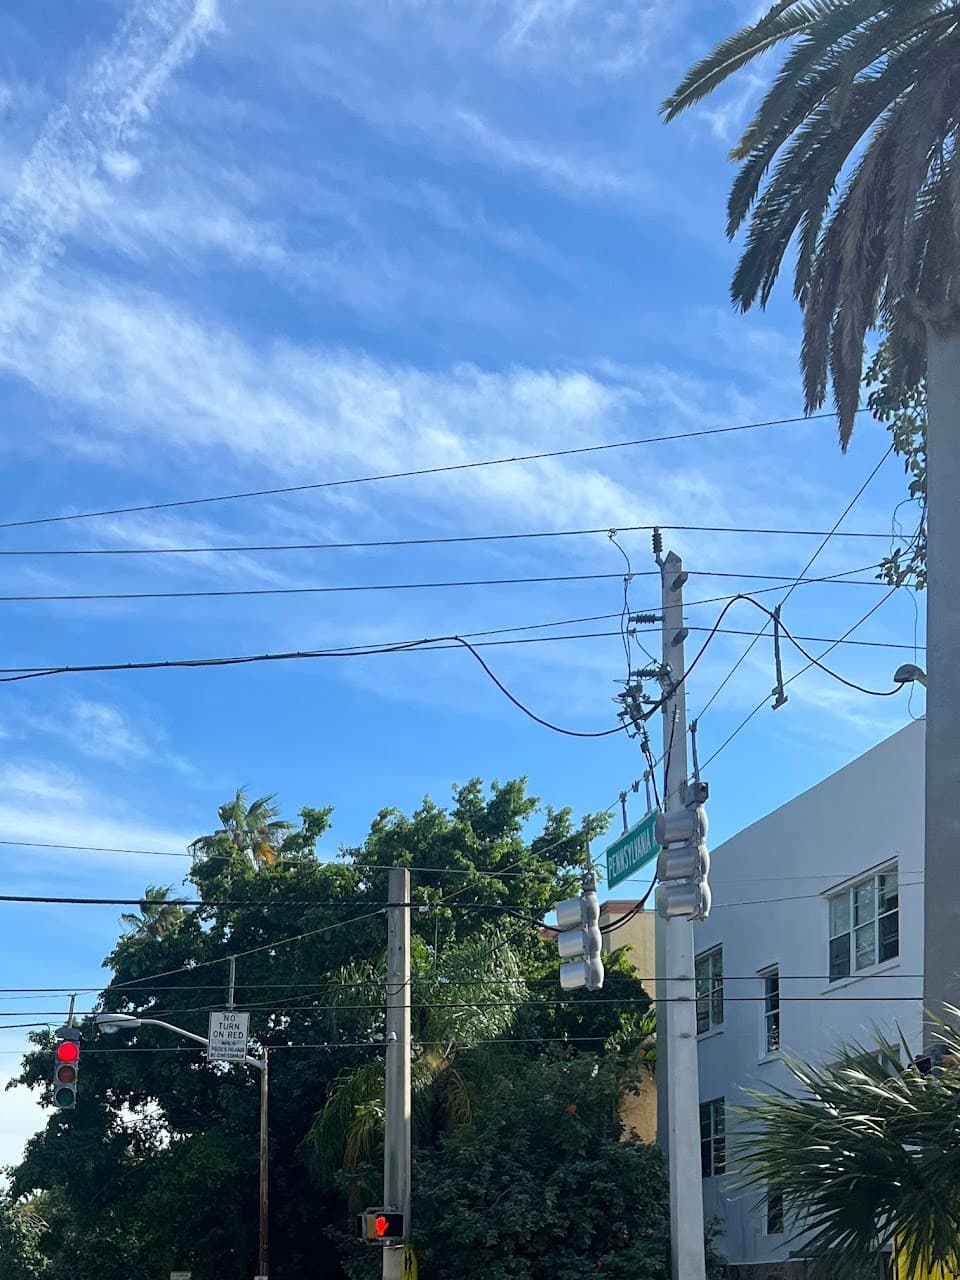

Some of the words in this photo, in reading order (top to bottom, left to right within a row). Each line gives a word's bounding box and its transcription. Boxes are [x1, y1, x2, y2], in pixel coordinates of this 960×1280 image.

[608, 828, 652, 880] PENNSYLVANIA
[223, 1014, 236, 1022] NO
[218, 1022, 240, 1031] TURN
[212, 1030, 224, 1038] ON
[227, 1031, 244, 1039] RED
